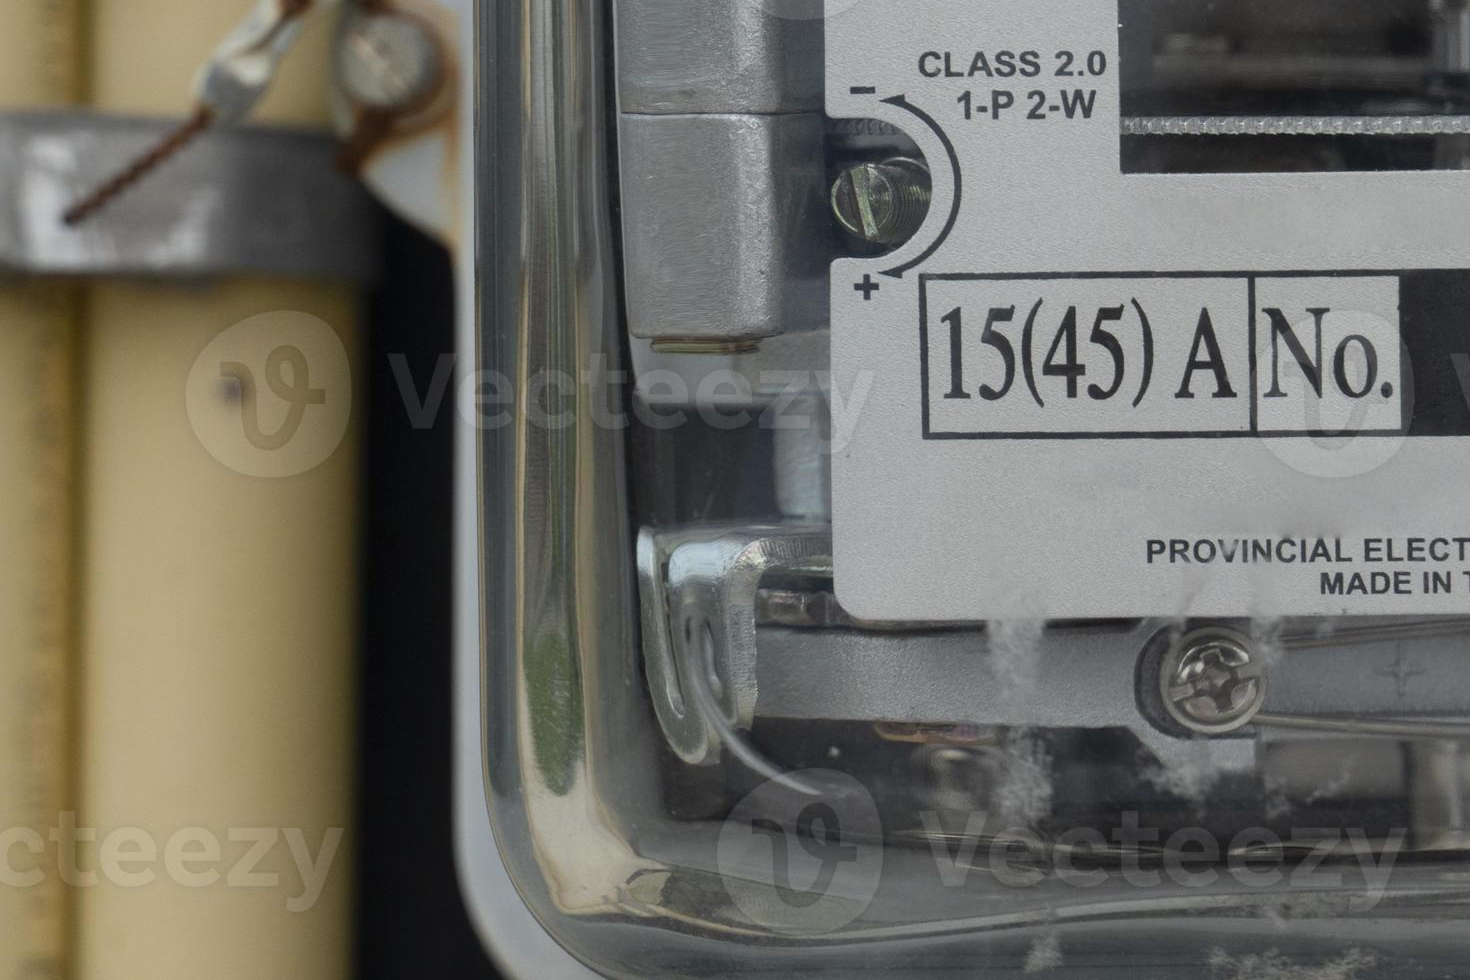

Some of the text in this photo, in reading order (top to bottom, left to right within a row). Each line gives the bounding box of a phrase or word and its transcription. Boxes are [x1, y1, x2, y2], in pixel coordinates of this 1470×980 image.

[918, 50, 1107, 77] CLASS 2.0
[957, 89, 1097, 120] 1-P 2-W
[941, 297, 1238, 408] 15(45) A
[1262, 307, 1394, 399] No.
[1146, 538, 1352, 564] PROVINCIAL
[1319, 571, 1412, 595] MADE
[1424, 571, 1451, 594] IN
